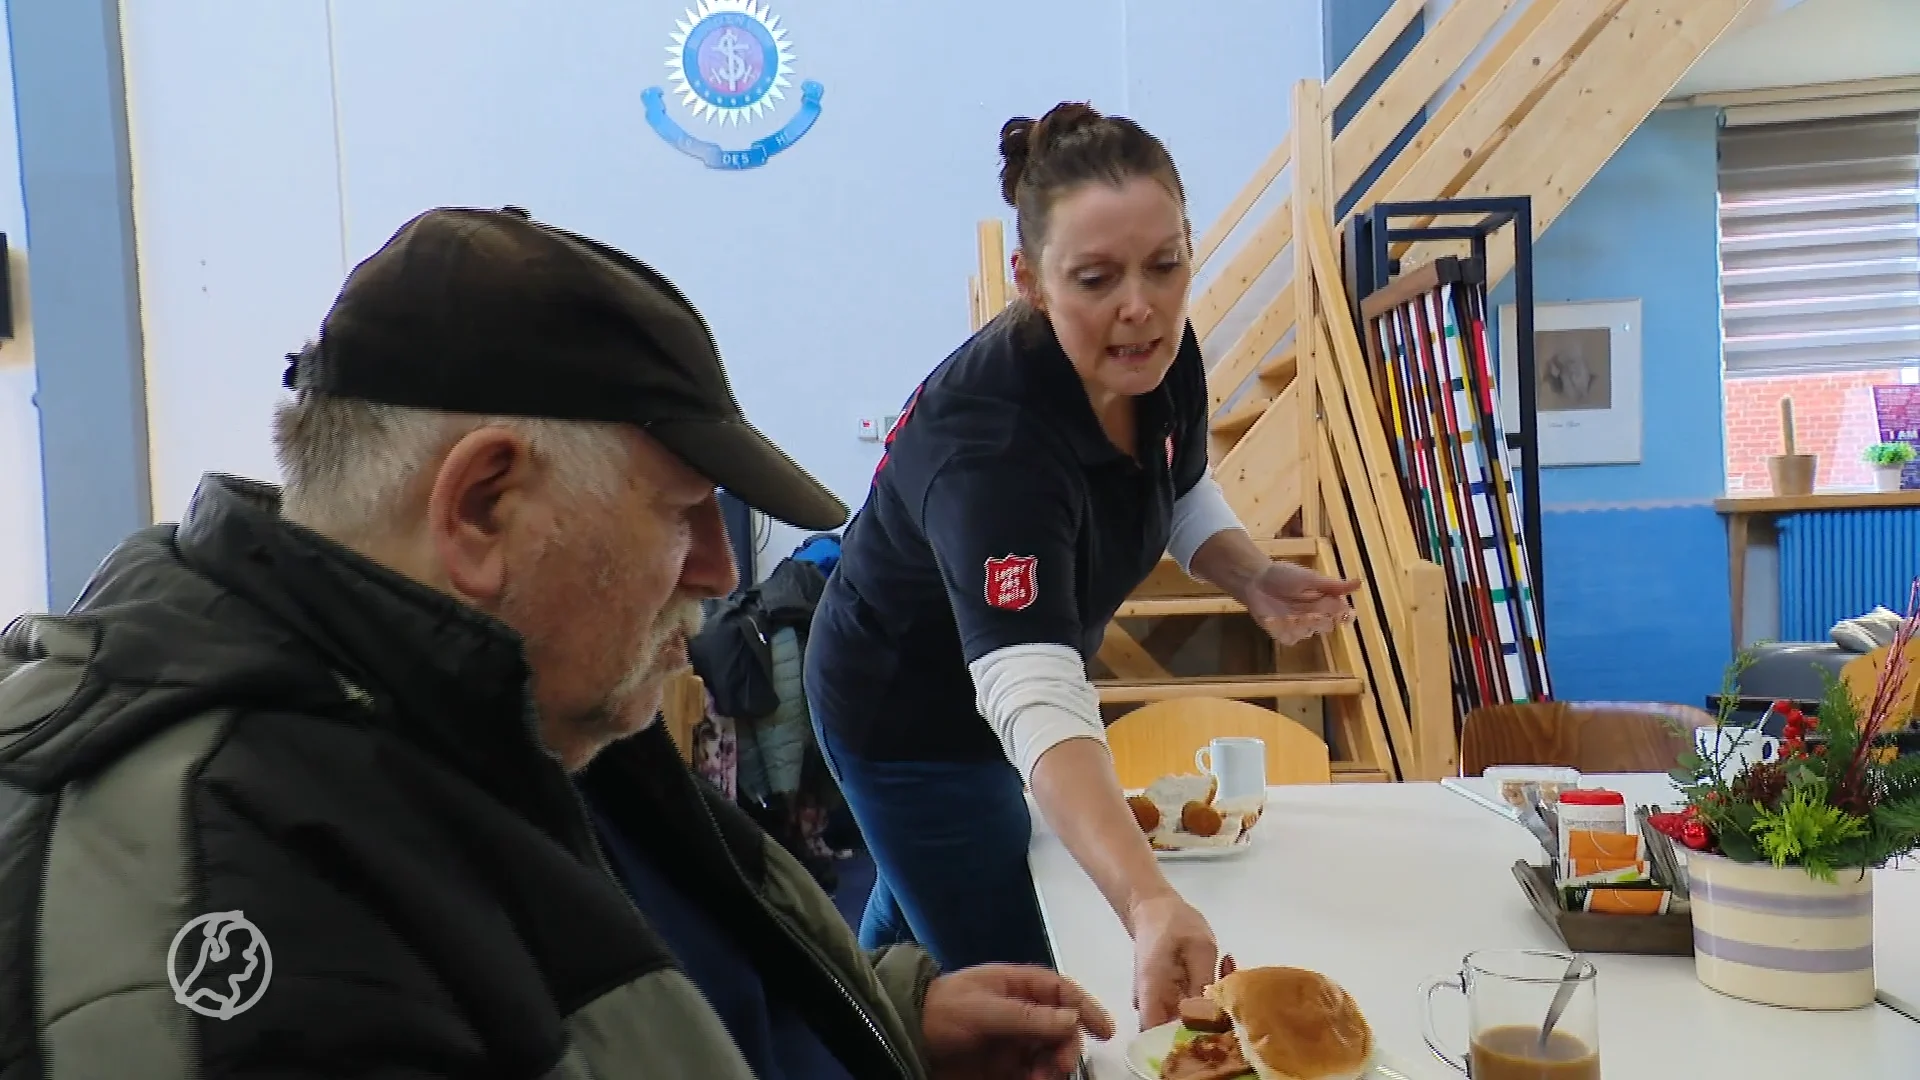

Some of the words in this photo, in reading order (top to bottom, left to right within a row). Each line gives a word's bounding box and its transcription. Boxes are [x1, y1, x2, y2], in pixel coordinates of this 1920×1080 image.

[722, 151, 750, 165] DES
[994, 564, 1027, 583] Leger
[1000, 576, 1020, 592] des
